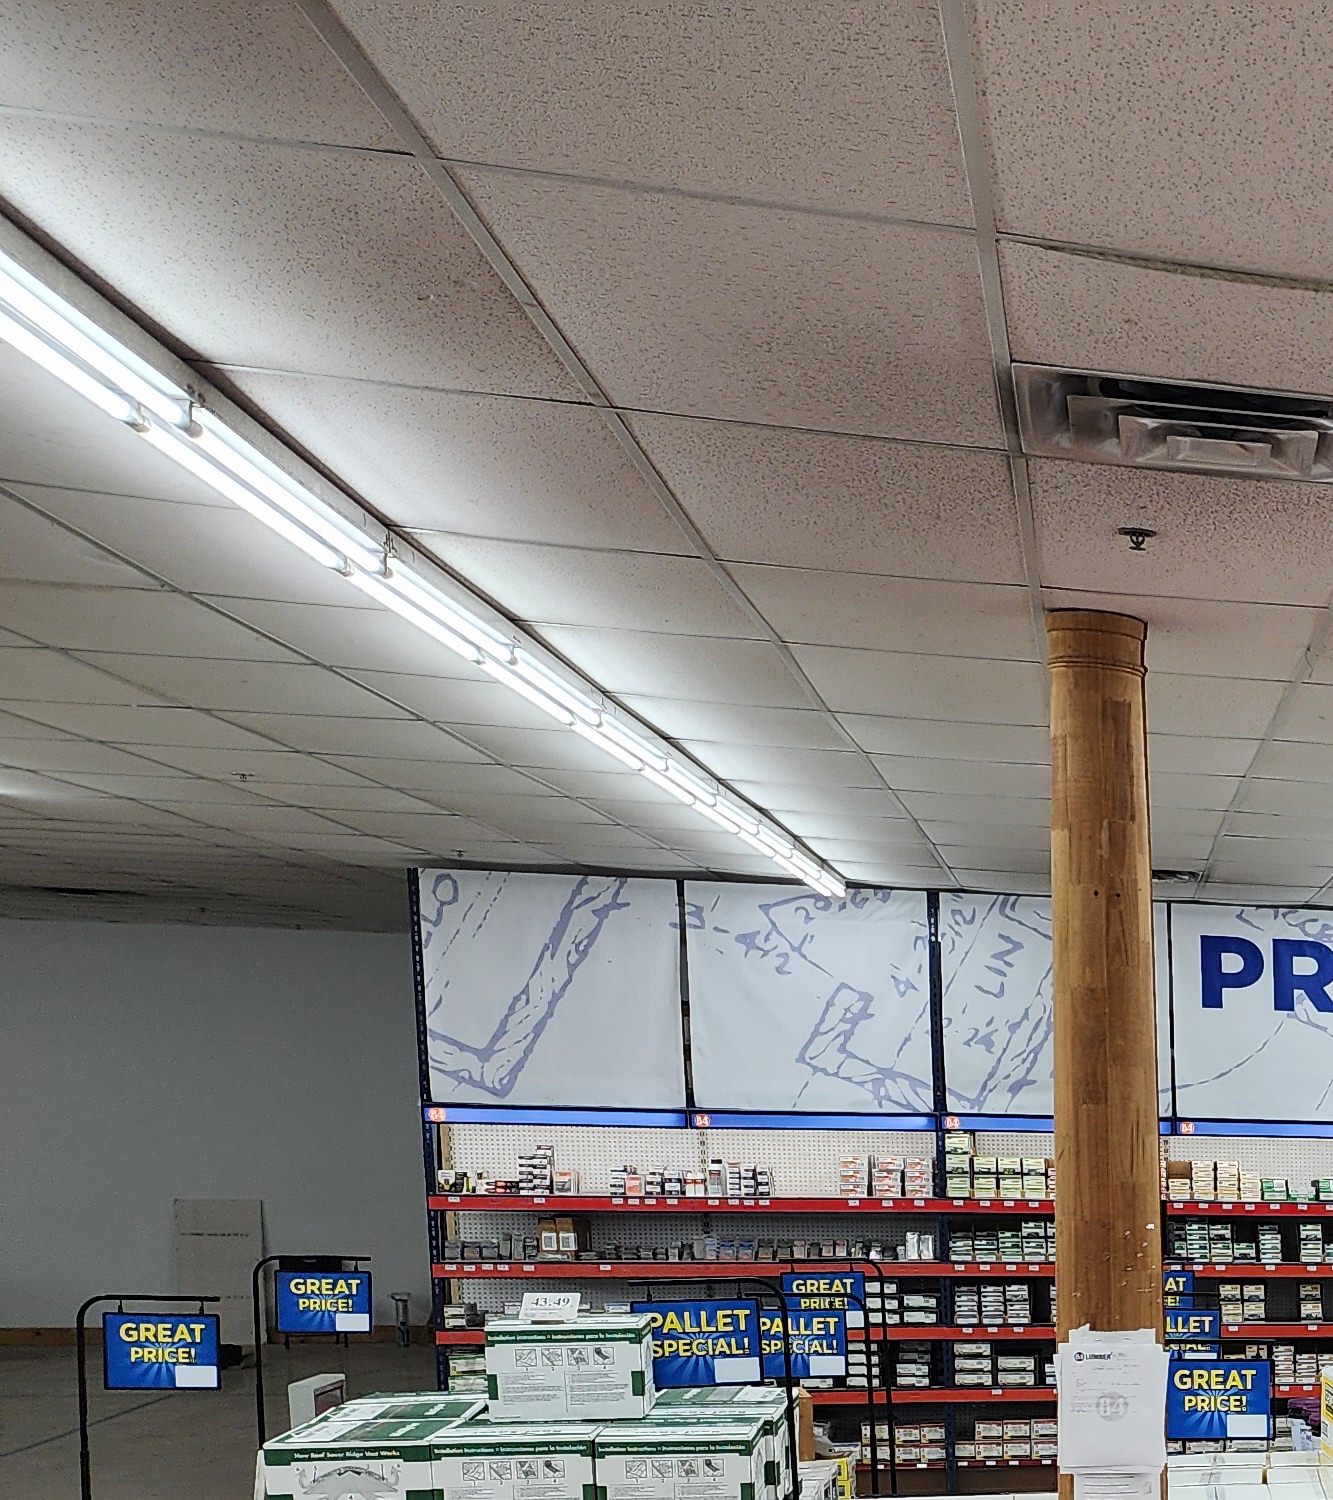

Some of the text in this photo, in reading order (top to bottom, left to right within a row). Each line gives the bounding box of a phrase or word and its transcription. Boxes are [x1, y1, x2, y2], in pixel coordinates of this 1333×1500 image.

[289, 1278, 361, 1295] GREAT
[792, 1278, 854, 1294] GREAT
[298, 1298, 353, 1312] PRICE!
[530, 1296, 571, 1308] 43.49
[650, 1309, 752, 1335] PALLET
[119, 1322, 206, 1343] GREAT
[129, 1346, 197, 1364] PRICE!
[652, 1337, 750, 1358] SPECIAL!
[761, 1338, 839, 1355] SPCIAL!
[1174, 1369, 1257, 1390] GREAT
[1184, 1395, 1248, 1413] PRICE!
